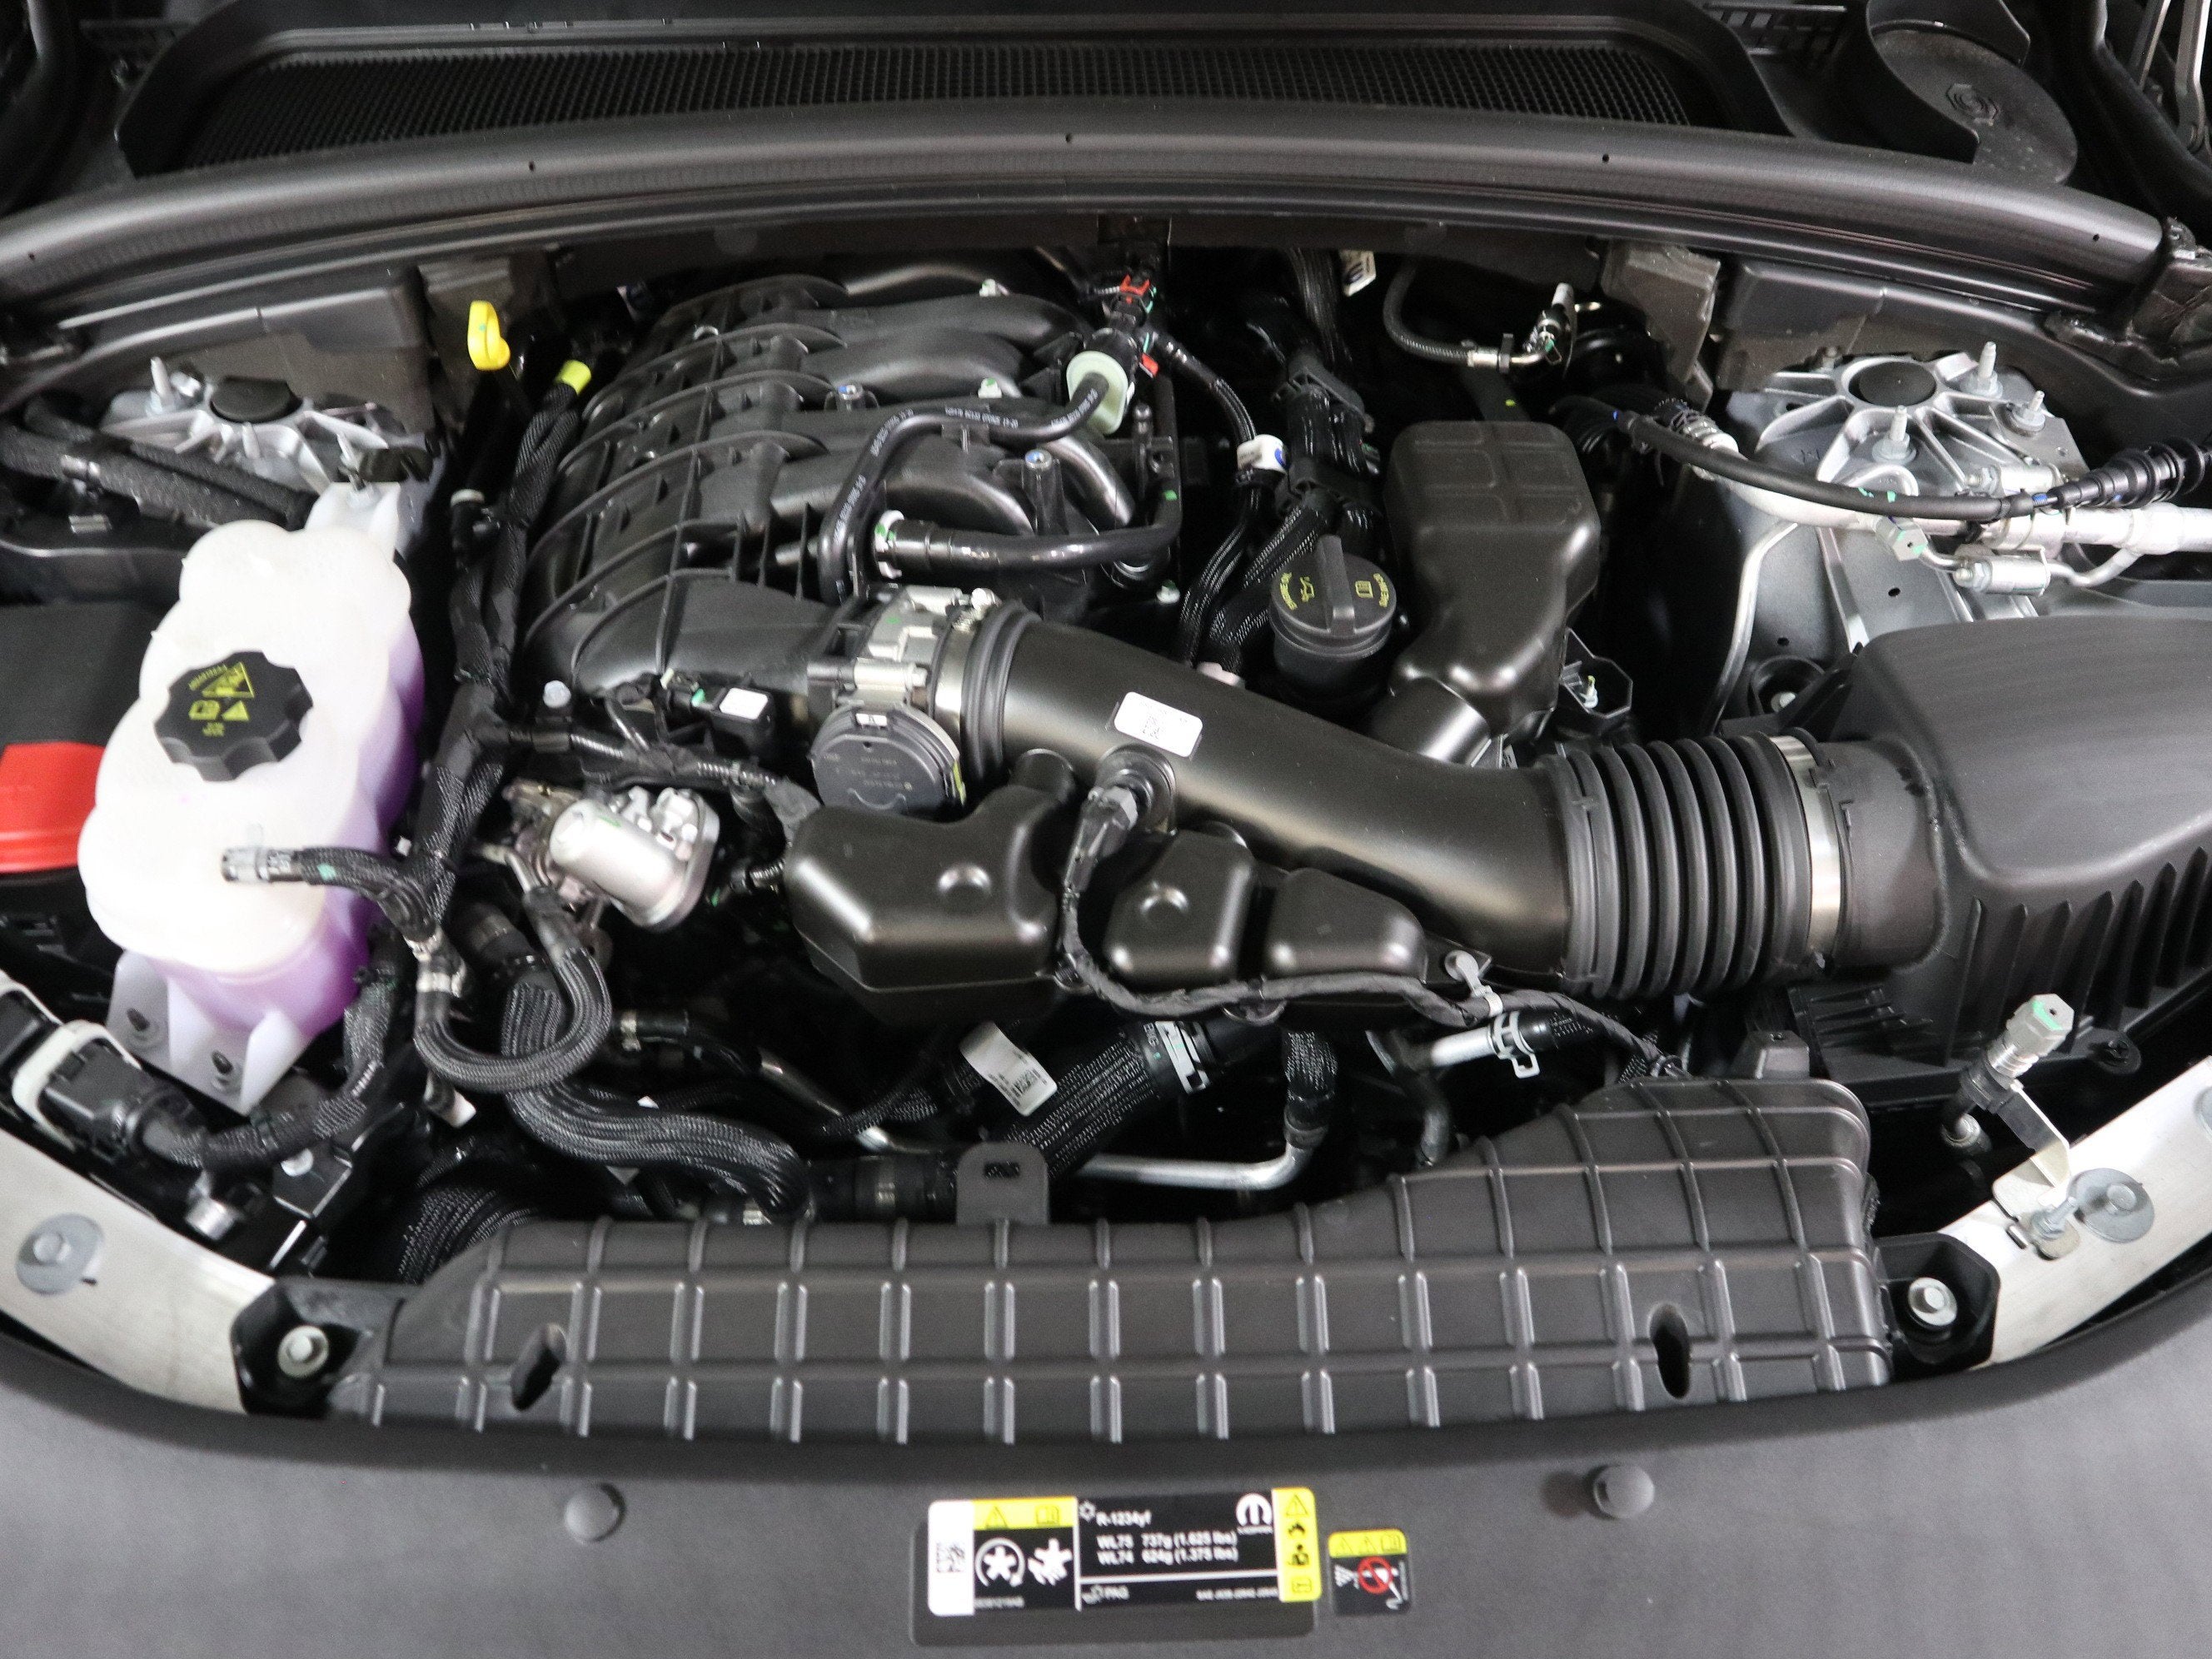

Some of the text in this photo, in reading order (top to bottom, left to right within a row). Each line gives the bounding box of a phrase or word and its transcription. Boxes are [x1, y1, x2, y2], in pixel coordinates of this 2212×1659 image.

[1143, 1023, 1158, 1046] ENG
[1096, 1510, 1152, 1528] R-1234yf
[1141, 1532, 1173, 1549] 737g
[1213, 1530, 1238, 1547] lbs)
[1142, 1547, 1173, 1566] 624g
[1213, 1546, 1238, 1562] lbs)
